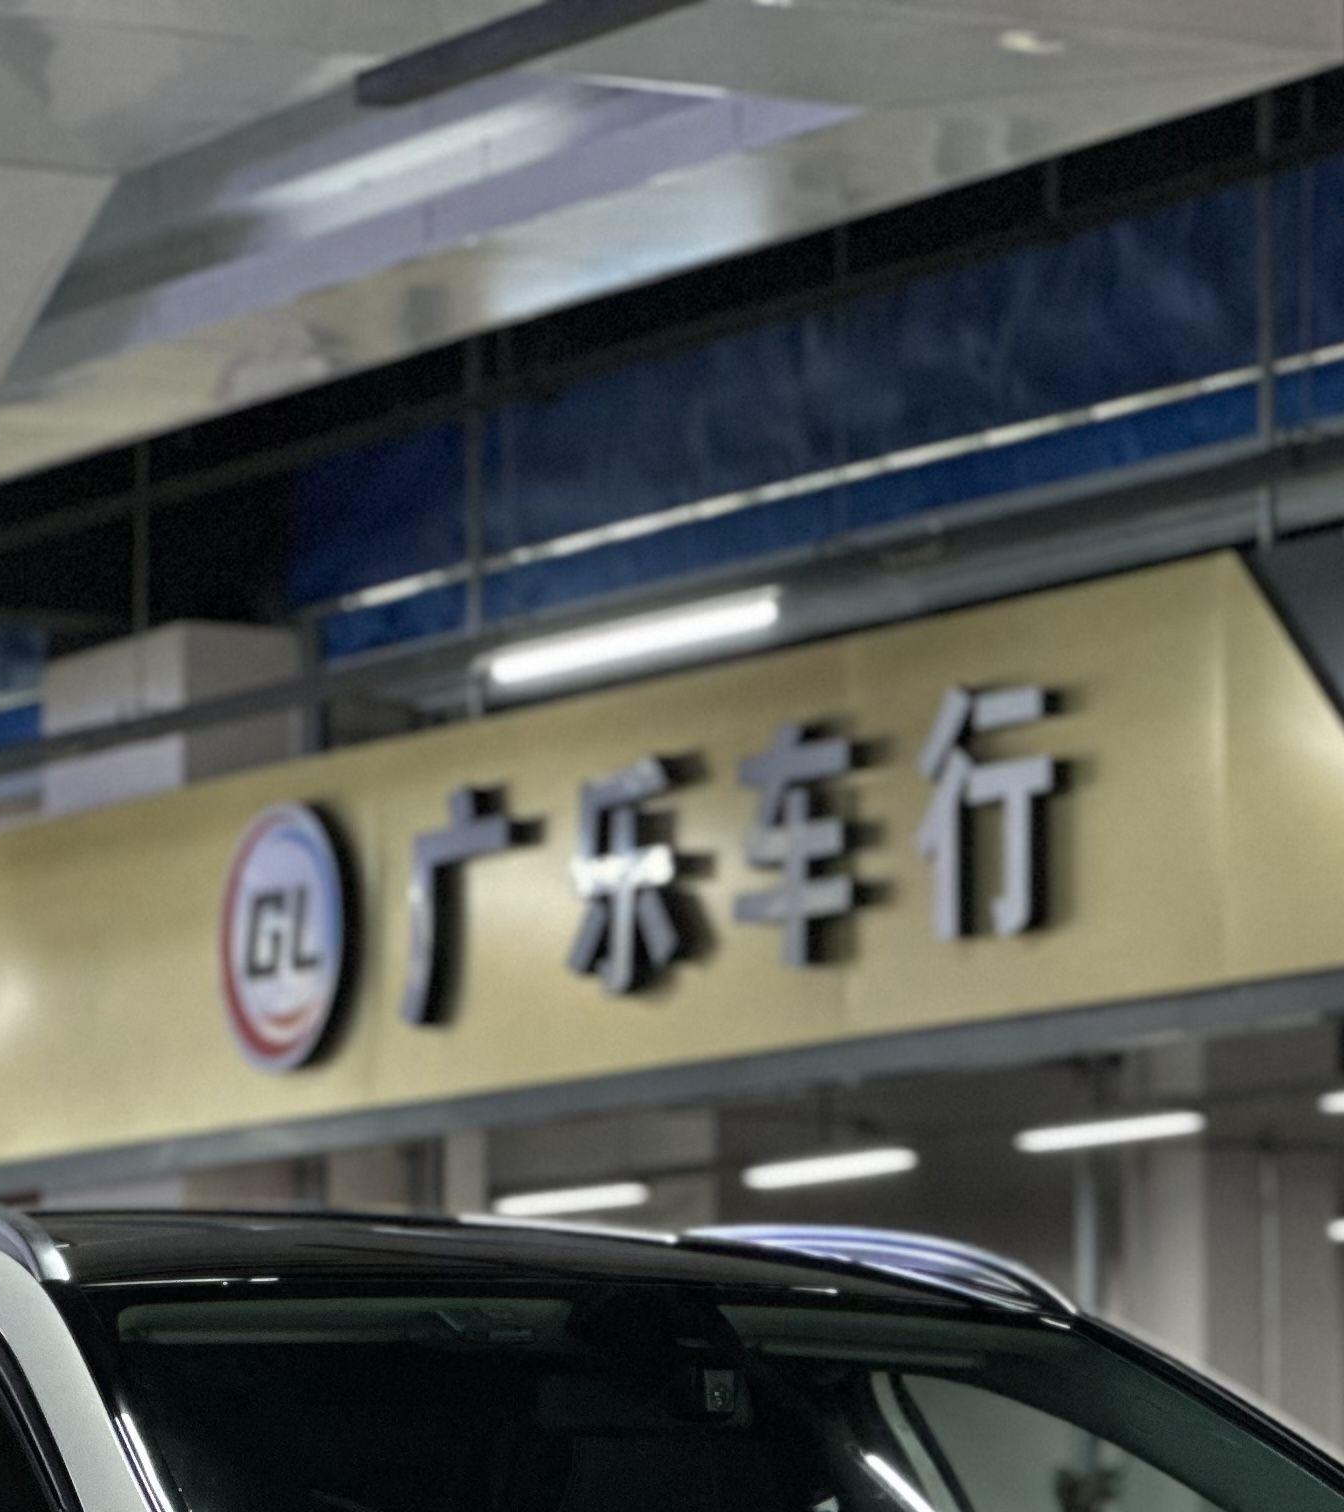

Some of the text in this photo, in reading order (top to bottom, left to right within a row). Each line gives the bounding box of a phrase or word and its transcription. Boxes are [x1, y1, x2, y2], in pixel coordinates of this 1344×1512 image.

[242, 890, 323, 979] GL
[402, 684, 1055, 1026] 广乐车行
